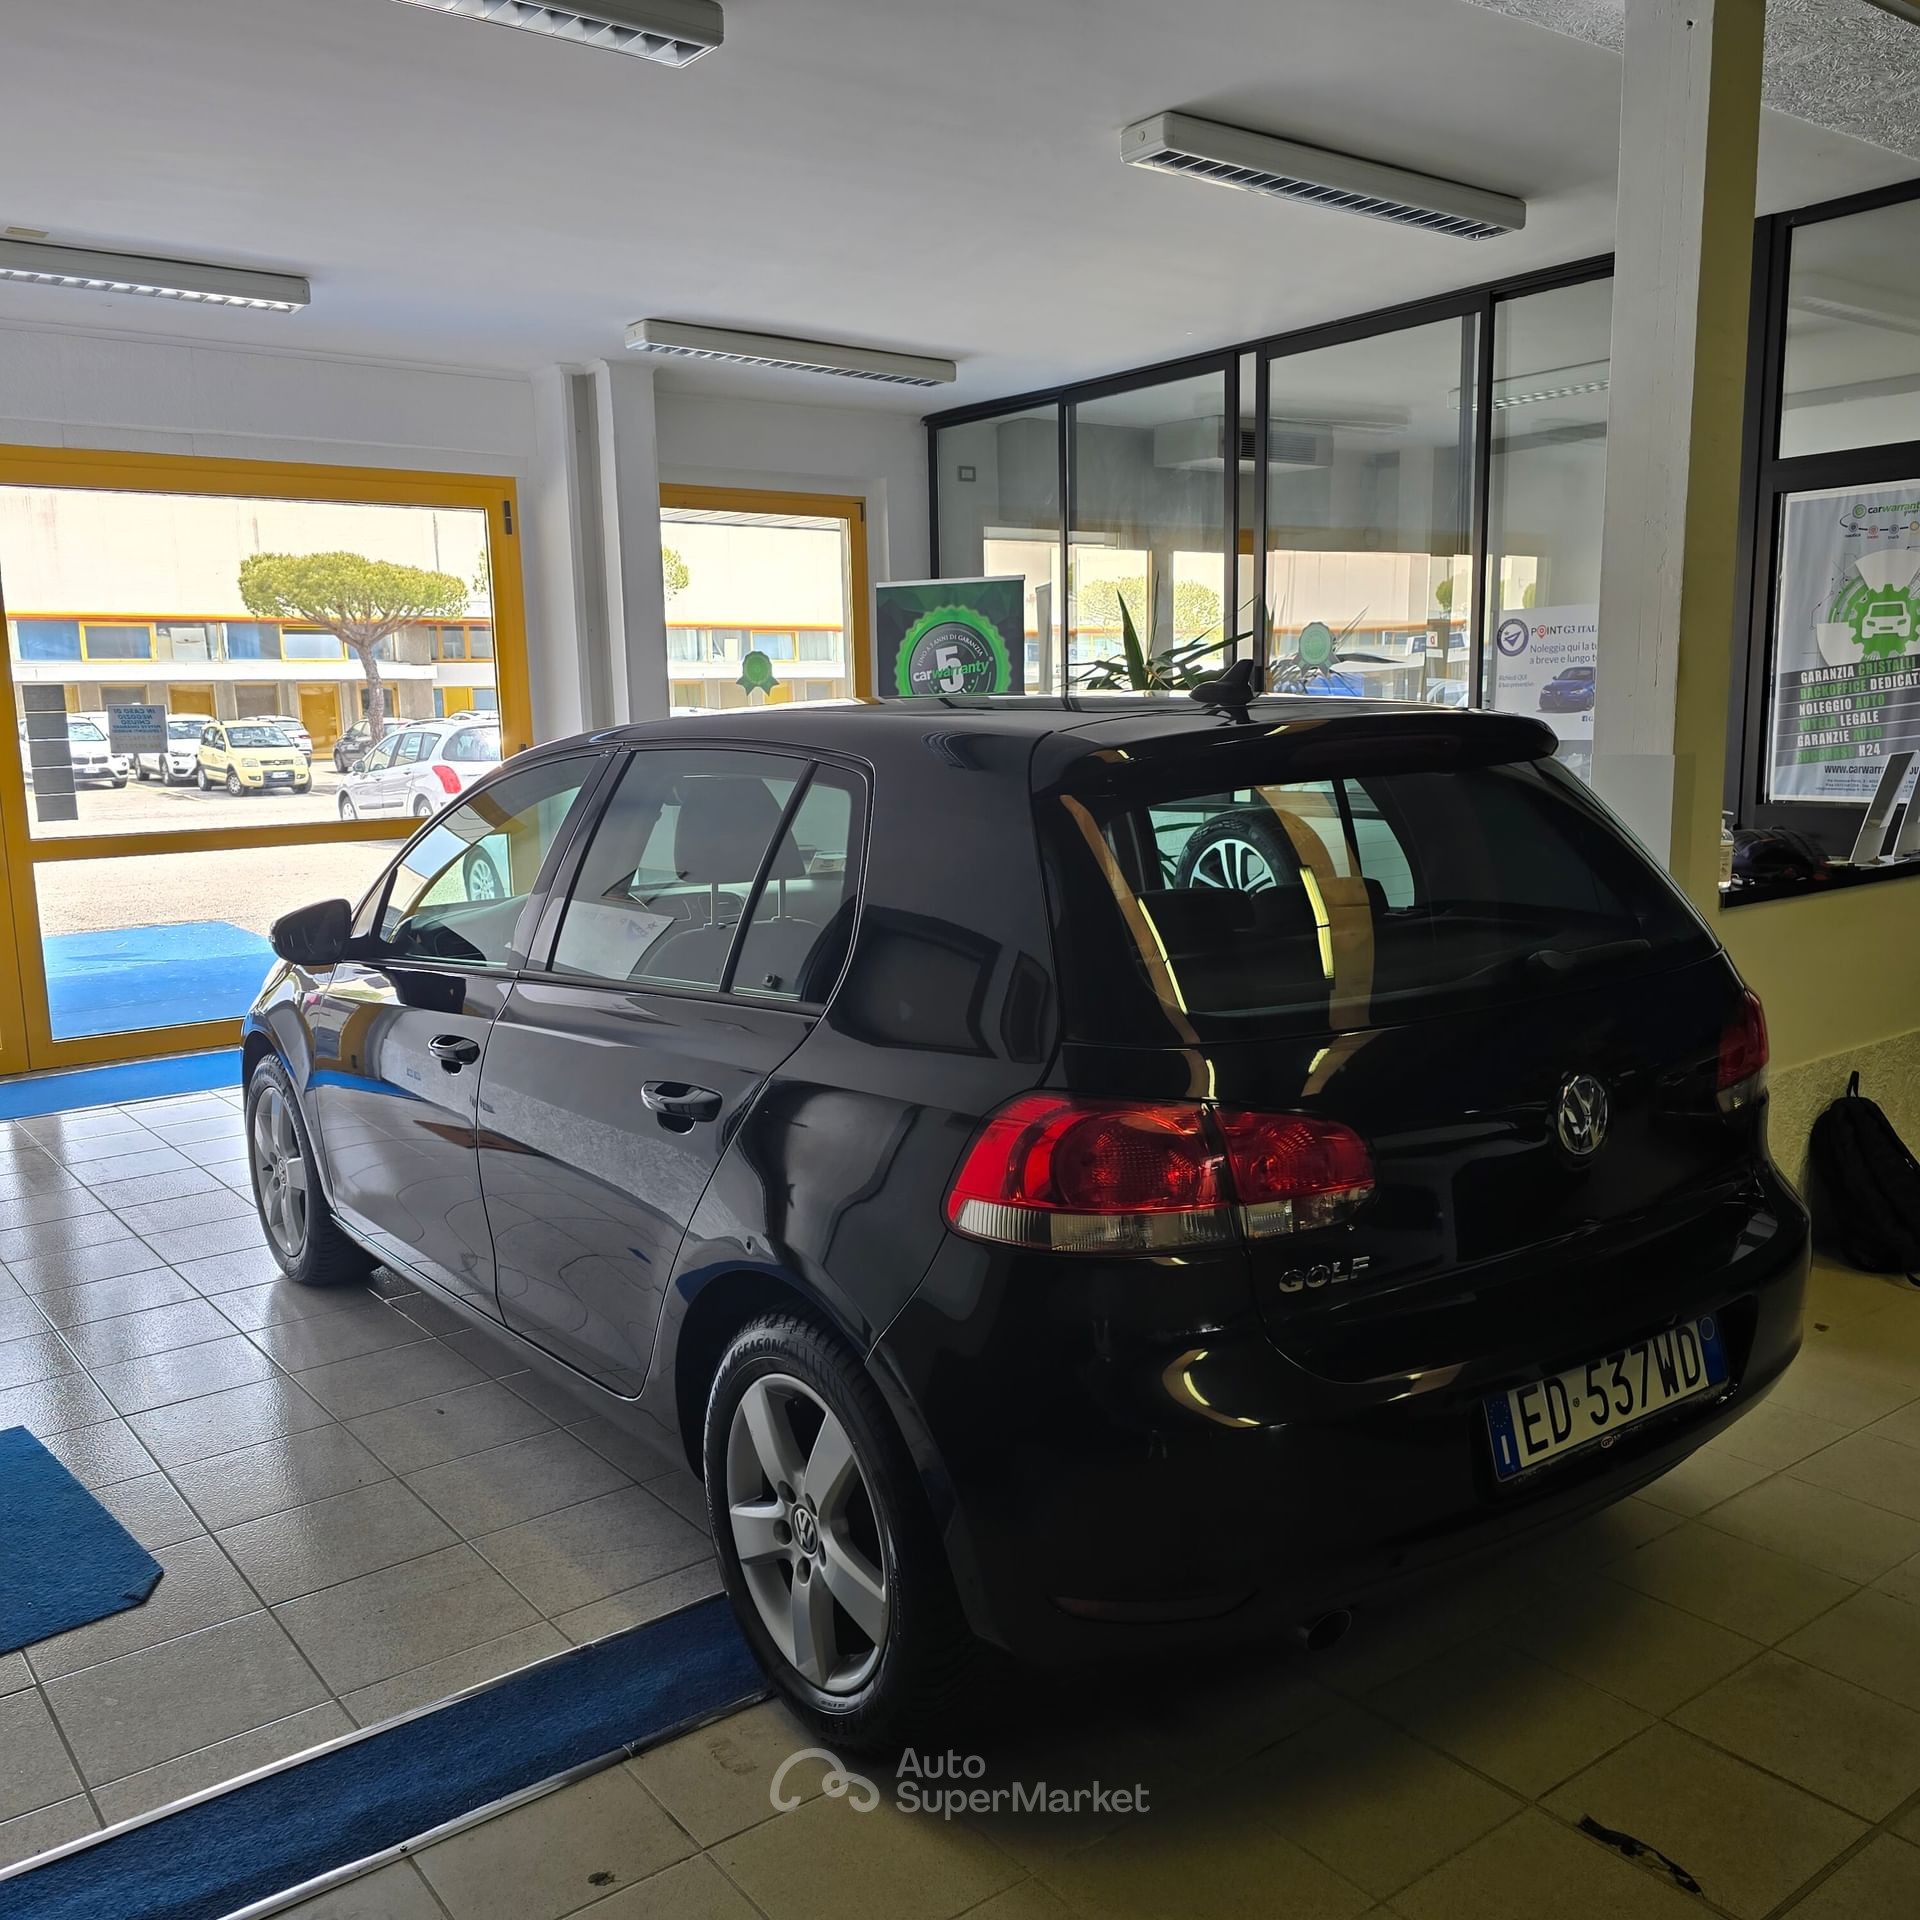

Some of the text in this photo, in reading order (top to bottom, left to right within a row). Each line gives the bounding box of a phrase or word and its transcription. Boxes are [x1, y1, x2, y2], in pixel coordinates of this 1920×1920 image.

[1867, 501, 1920, 514] carwarrant
[1577, 625, 1597, 633] ITAL
[958, 635, 984, 657] GARANZIA
[1530, 644, 1565, 654] Noleggia
[1567, 642, 1579, 652] qui
[1582, 642, 1589, 650] la
[936, 645, 964, 693] 5
[1535, 656, 1560, 665] breve
[1567, 654, 1590, 664] lungo
[912, 660, 989, 682] carwarranty
[1801, 657, 1916, 684] GARANZIA CRISTALLI
[1800, 672, 1920, 699] BACKOFFICE DEDICAT
[1799, 694, 1885, 716] NOLEGGIO AUTO
[1840, 711, 1879, 726] LEGALE
[1797, 726, 1883, 747] GARANZIE AUTO
[1858, 743, 1880, 756] H24
[1279, 1256, 1370, 1293] GOLF
